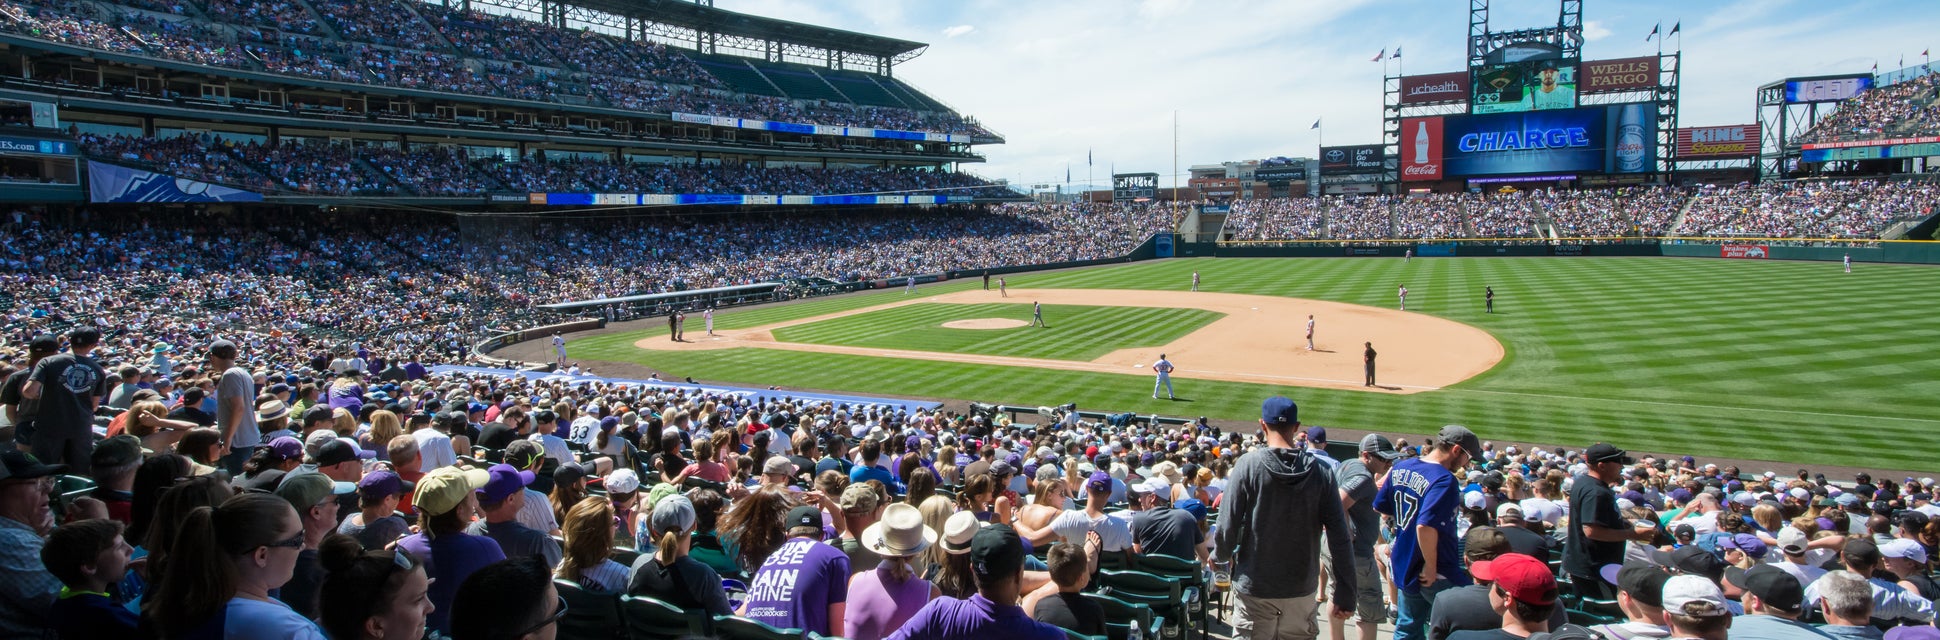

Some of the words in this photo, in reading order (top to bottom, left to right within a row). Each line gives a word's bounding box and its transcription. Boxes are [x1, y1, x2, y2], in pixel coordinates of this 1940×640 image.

[1589, 62, 1649, 75] WELLS
[1590, 73, 1648, 87] FARGO
[1411, 81, 1459, 95] uchealth
[1459, 127, 1590, 153] CHARGE
[1692, 127, 1746, 142] KING
[0, 140, 35, 151] ES.com
[1691, 142, 1746, 156] Soopers
[1727, 250, 1743, 258] plus
[571, 425, 590, 440] 33
[1394, 490, 1419, 531] 17
